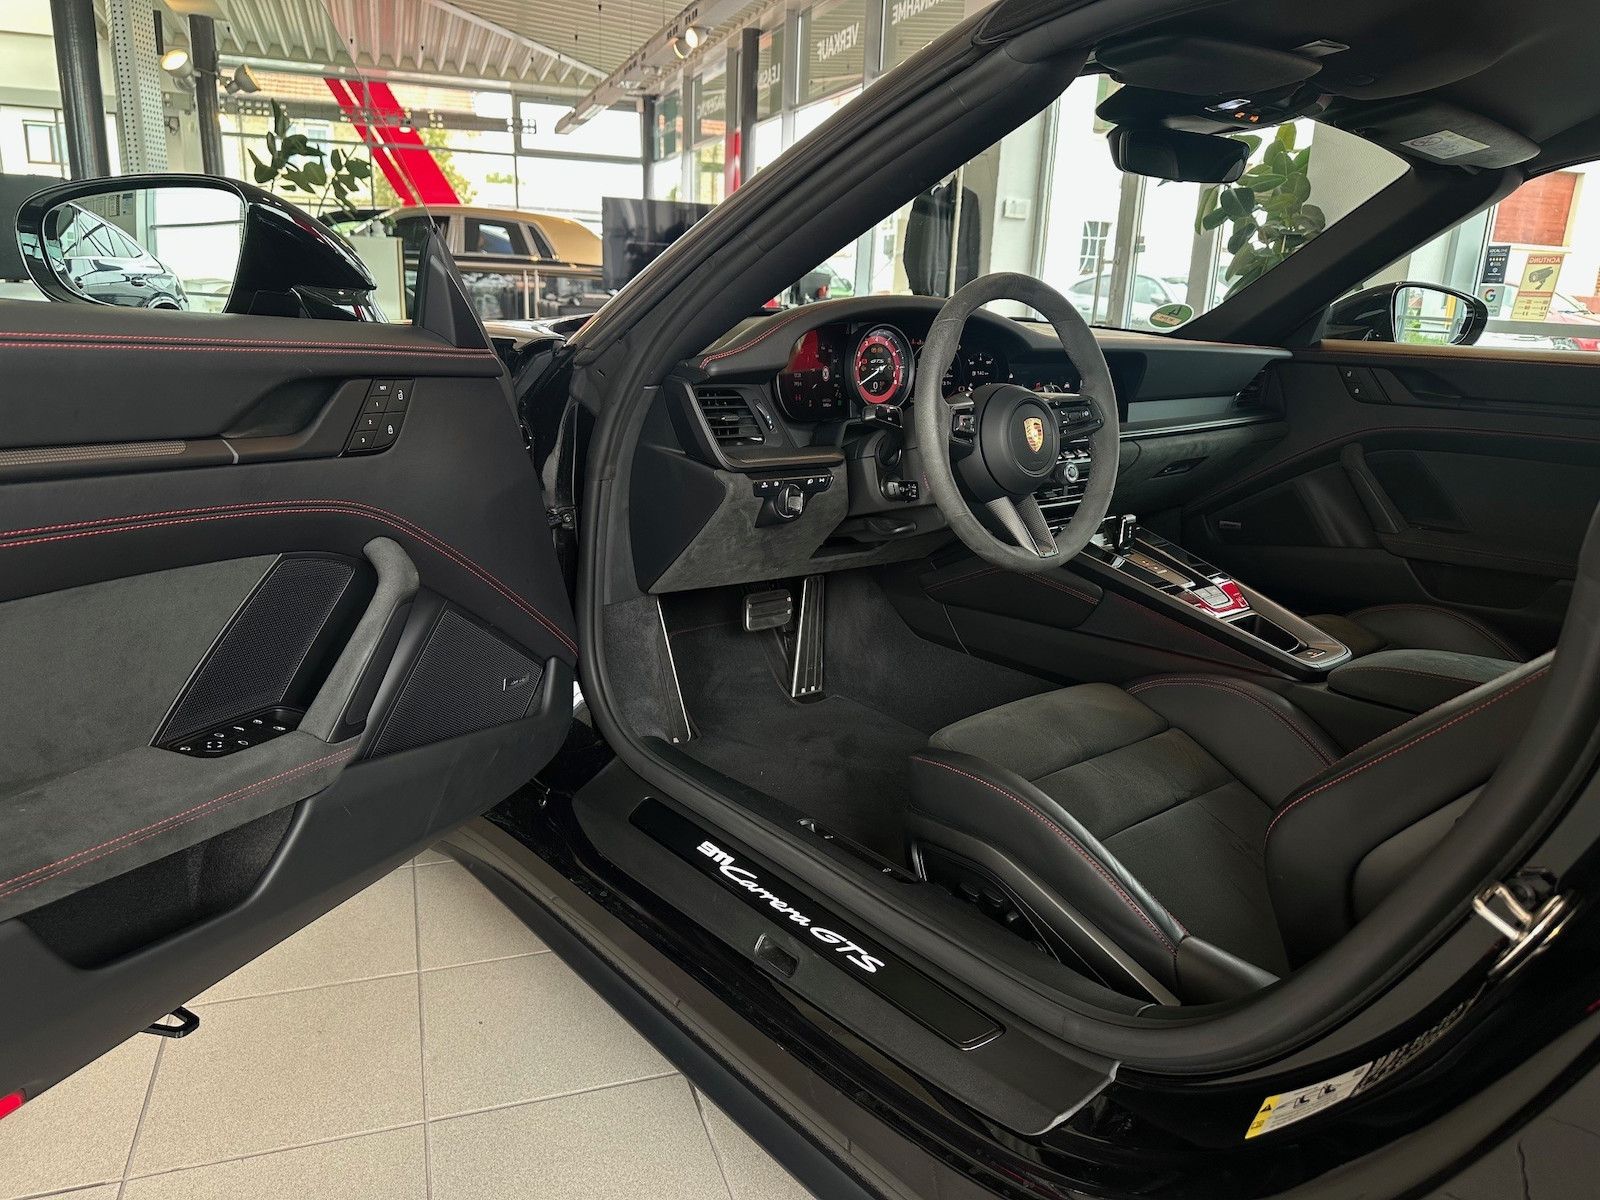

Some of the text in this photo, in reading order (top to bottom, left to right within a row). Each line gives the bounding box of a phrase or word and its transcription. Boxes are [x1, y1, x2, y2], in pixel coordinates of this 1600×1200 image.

[1484, 288, 1496, 303] G
[719, 865, 811, 927] Carrera
[809, 926, 885, 973] GTS
